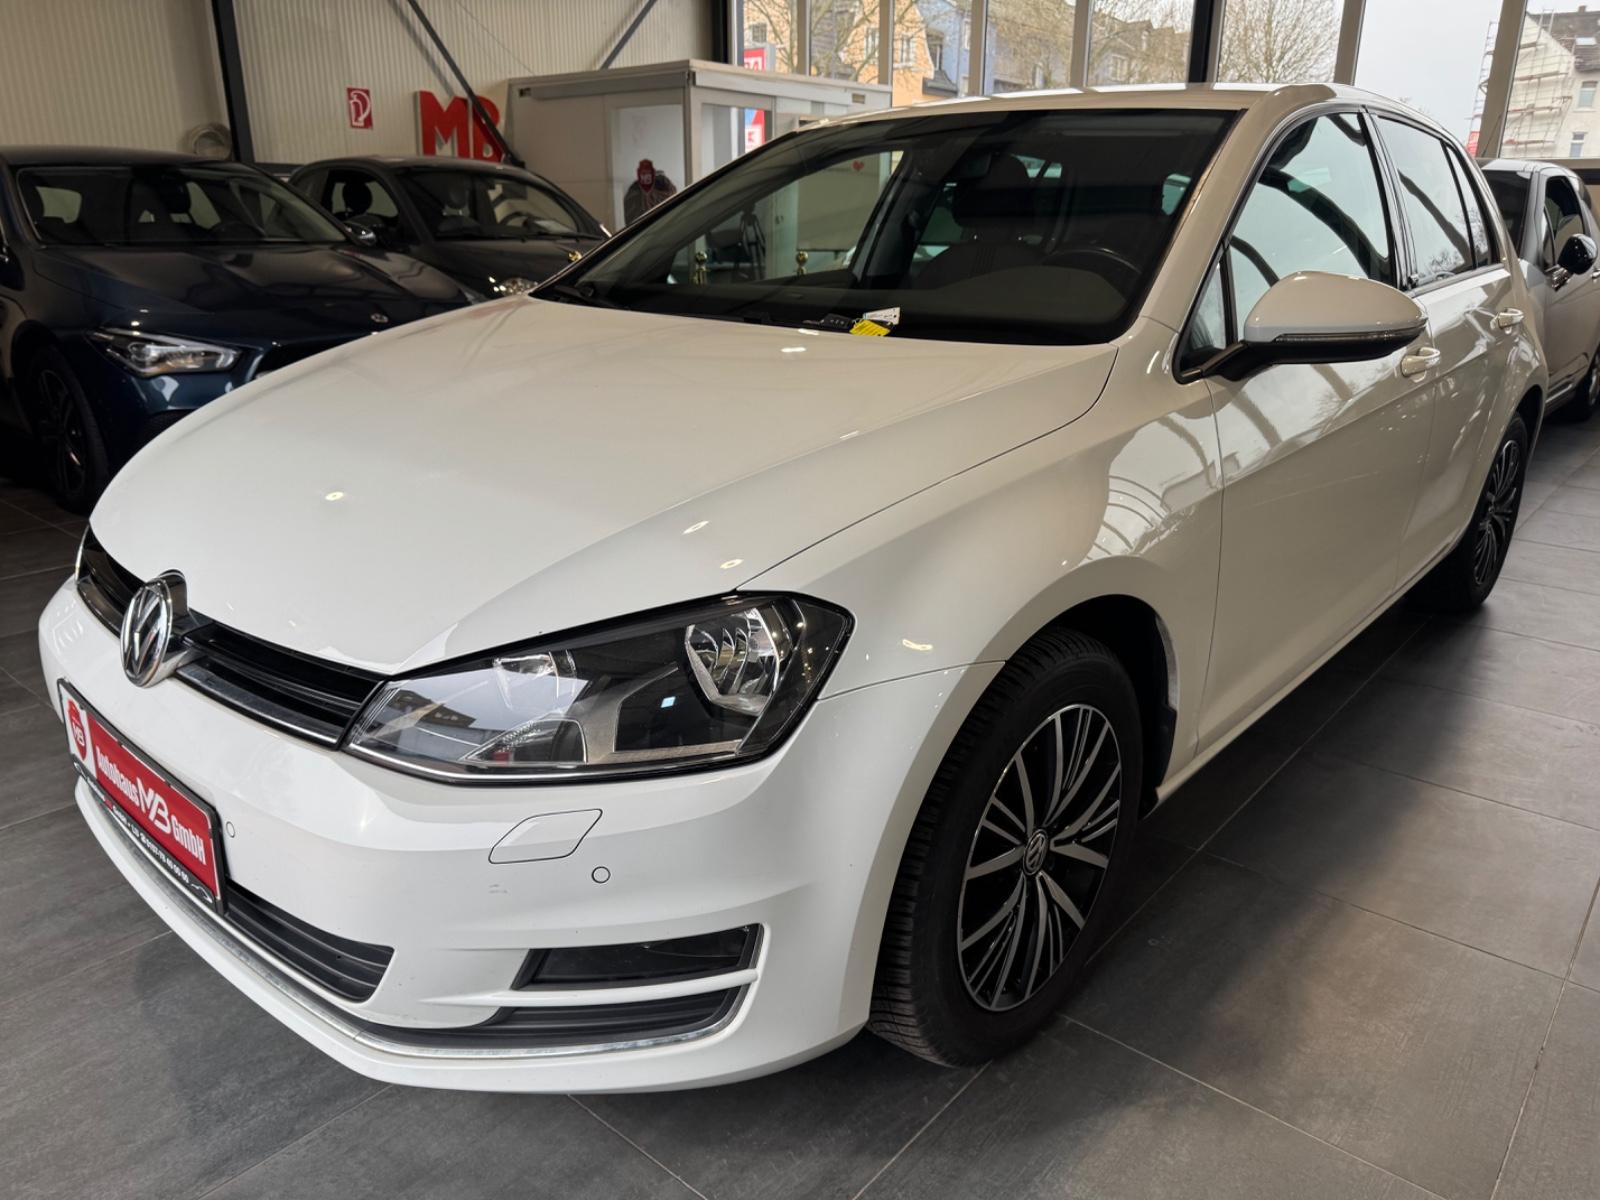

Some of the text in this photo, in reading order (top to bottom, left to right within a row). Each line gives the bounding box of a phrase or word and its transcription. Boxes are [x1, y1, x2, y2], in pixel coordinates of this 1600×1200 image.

[418, 90, 502, 163] MB
[96, 745, 140, 807] Autohaus
[136, 777, 171, 835] MB
[171, 814, 207, 866] GmbH
